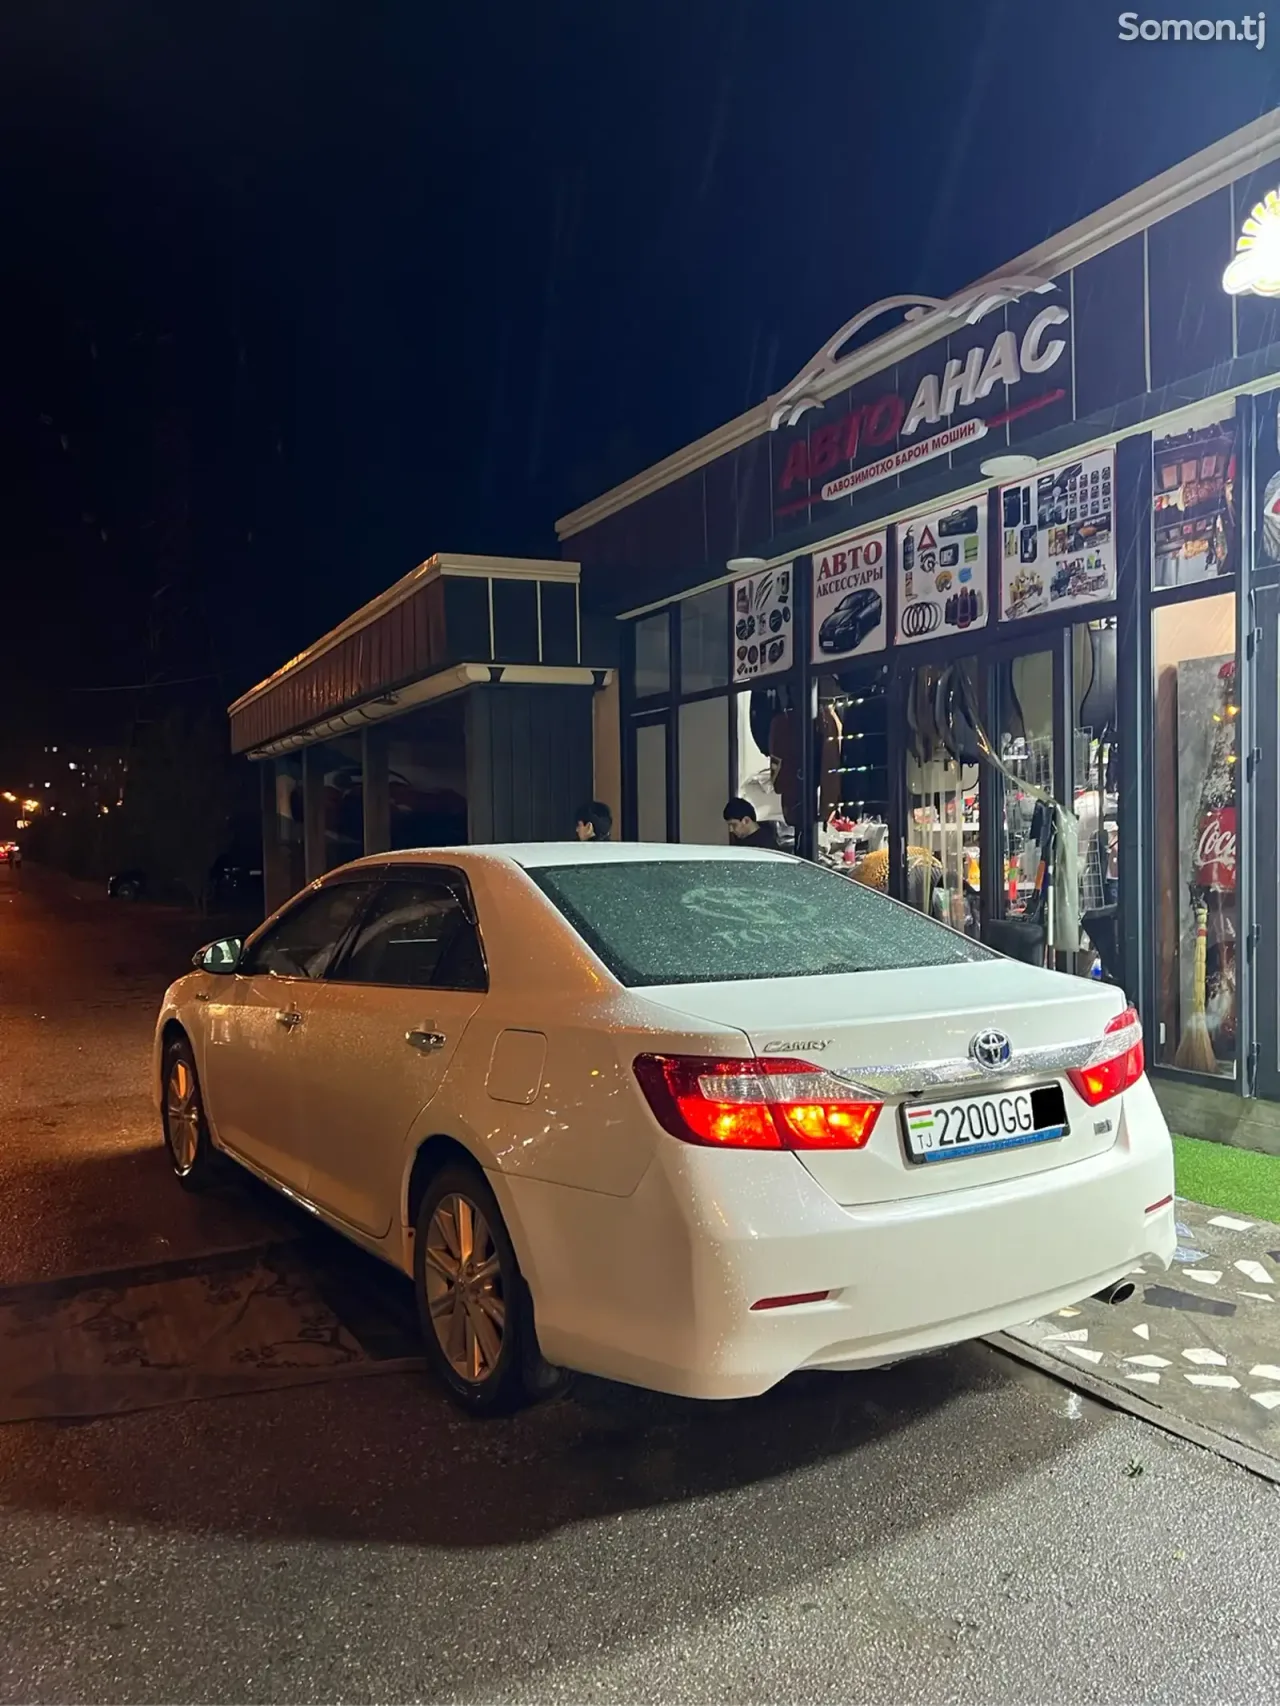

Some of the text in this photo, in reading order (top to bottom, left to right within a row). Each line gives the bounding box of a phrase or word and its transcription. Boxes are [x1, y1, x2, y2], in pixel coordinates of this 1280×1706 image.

[931, 422, 976, 449] МОШИН
[816, 541, 883, 582] АВТО
[816, 566, 884, 599] АКСЕССУАРЫ
[917, 1133, 933, 1150] TJ
